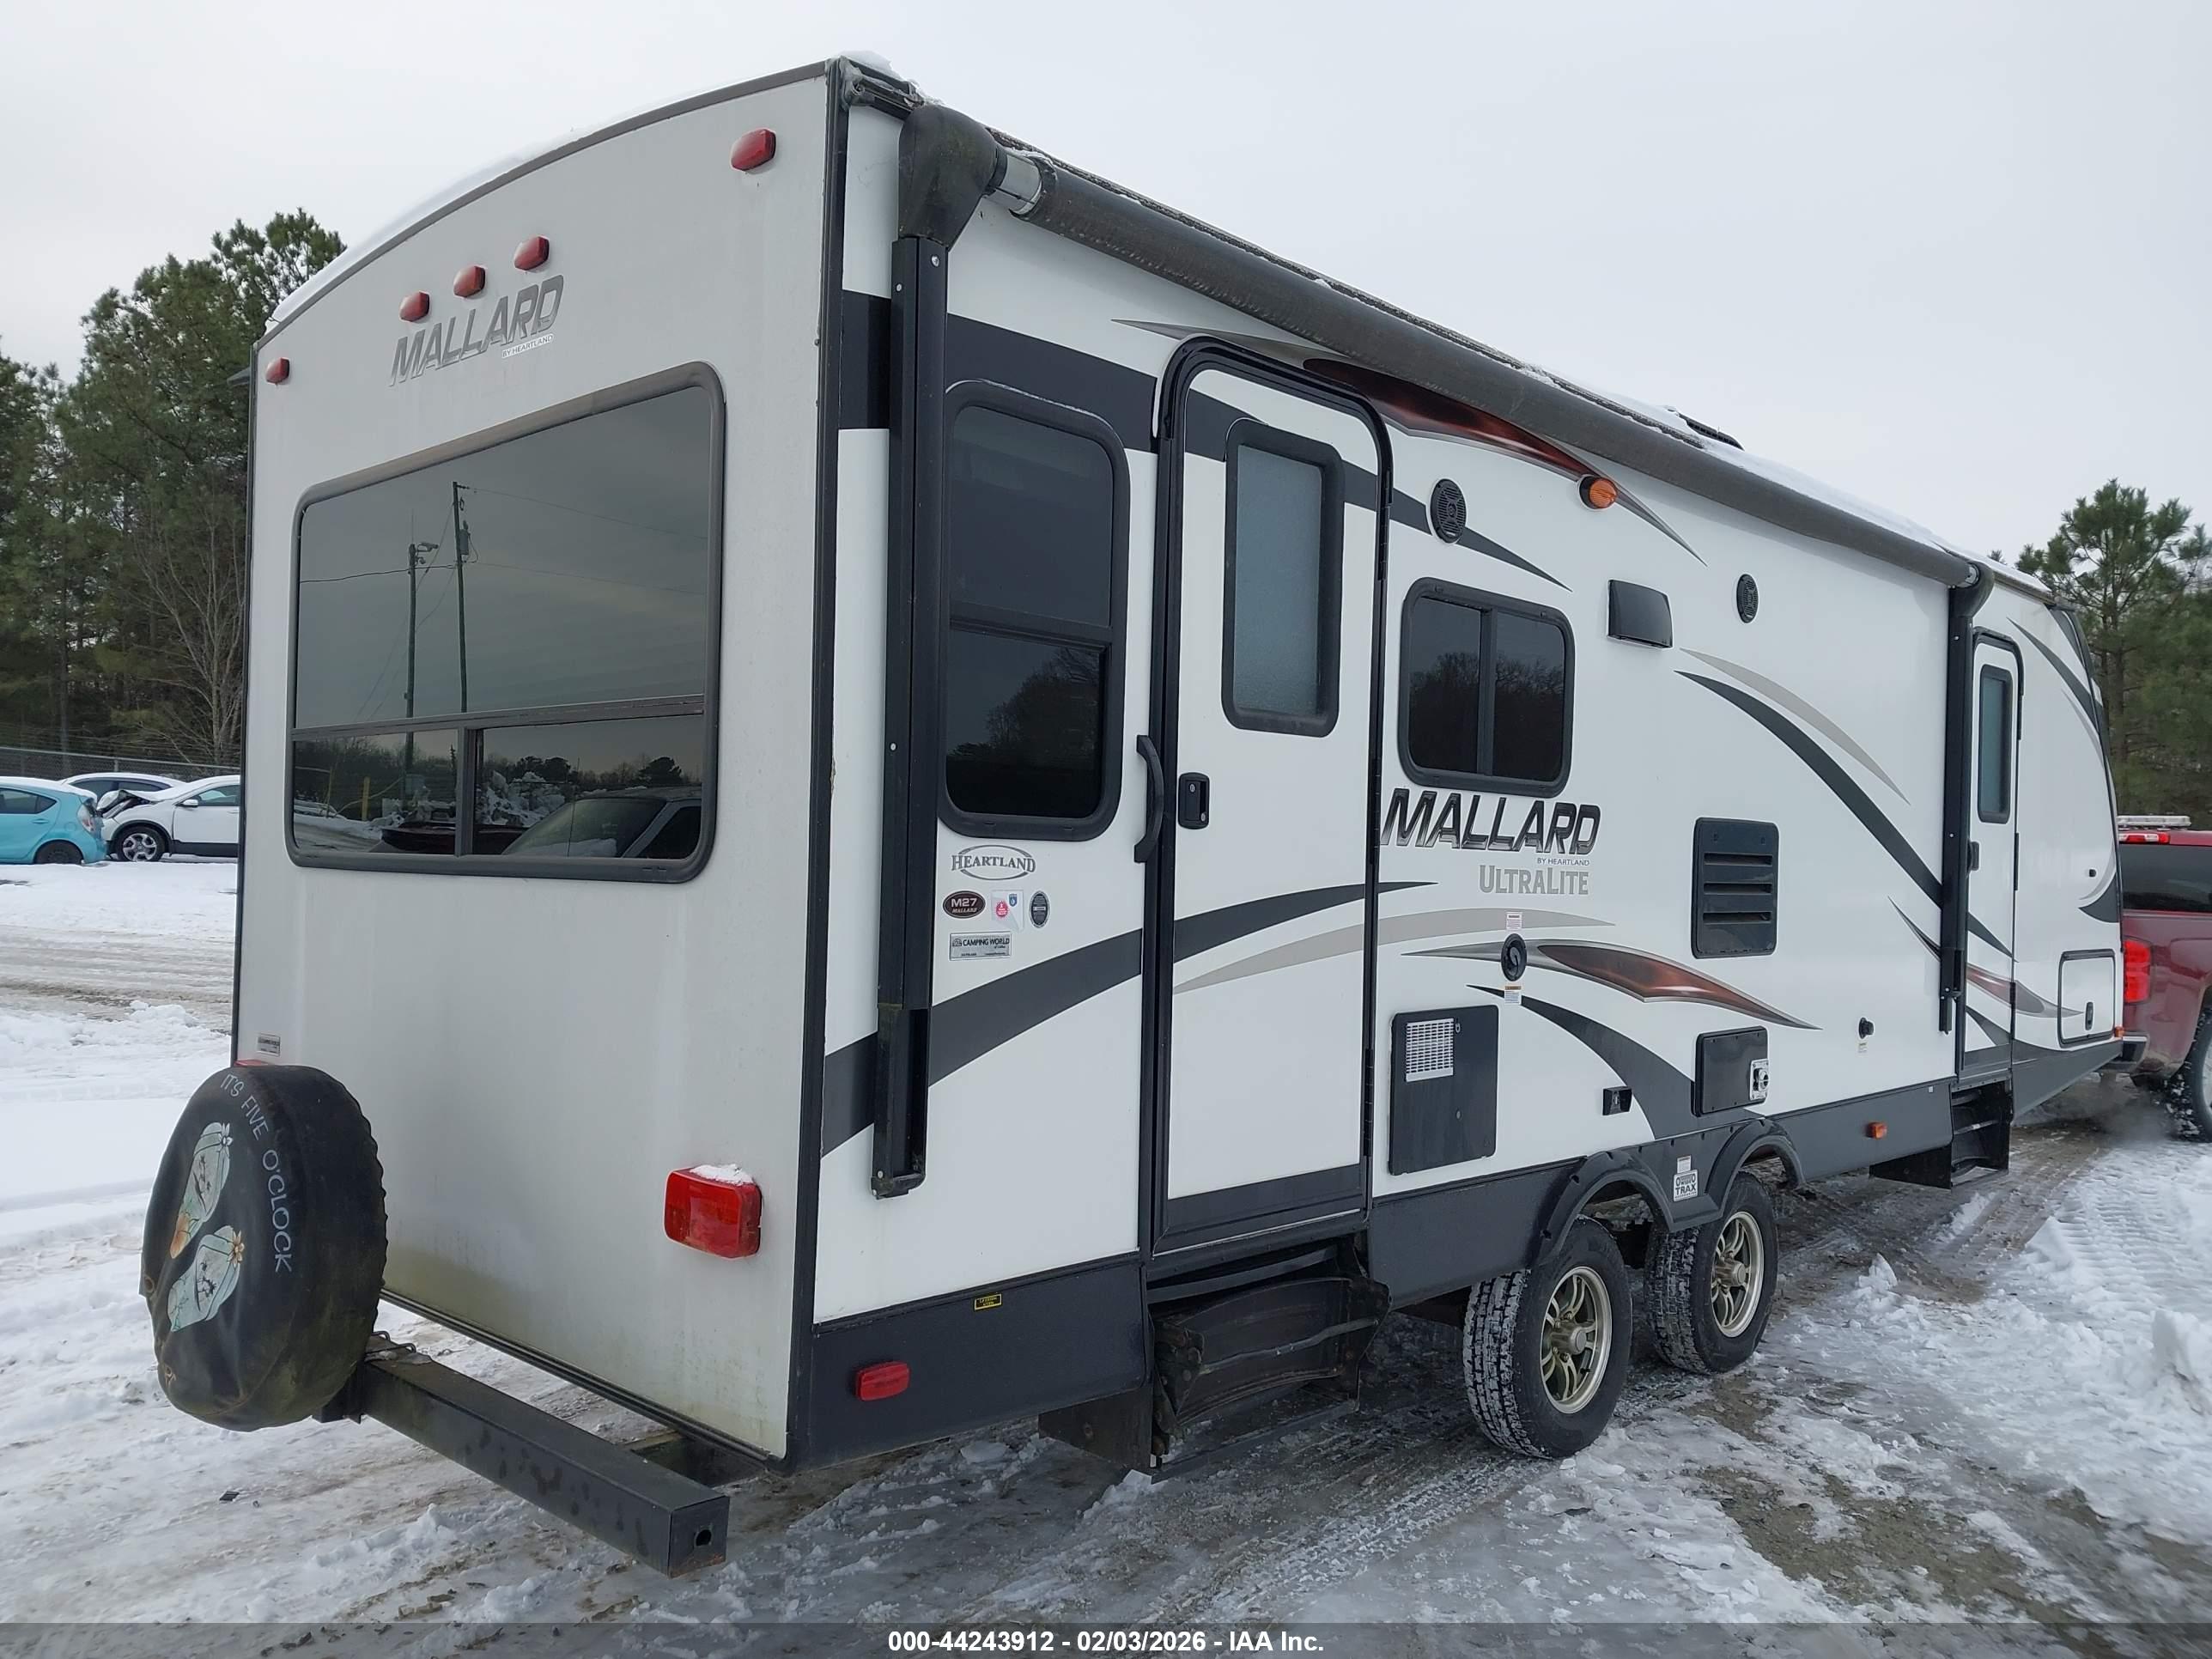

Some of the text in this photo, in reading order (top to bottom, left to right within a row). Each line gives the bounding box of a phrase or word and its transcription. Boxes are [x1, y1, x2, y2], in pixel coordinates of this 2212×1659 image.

[389, 275, 563, 386] MALLARD
[502, 334, 554, 357] BY HEARTLAND
[1381, 787, 1601, 854] MALLARD
[951, 854, 1036, 872] HEARTLAND
[951, 897, 977, 908] M27
[240, 1095, 269, 1141] FIVE
[263, 1149, 292, 1272] O'CLOCK
[1675, 1183, 1697, 1196] TRAX
